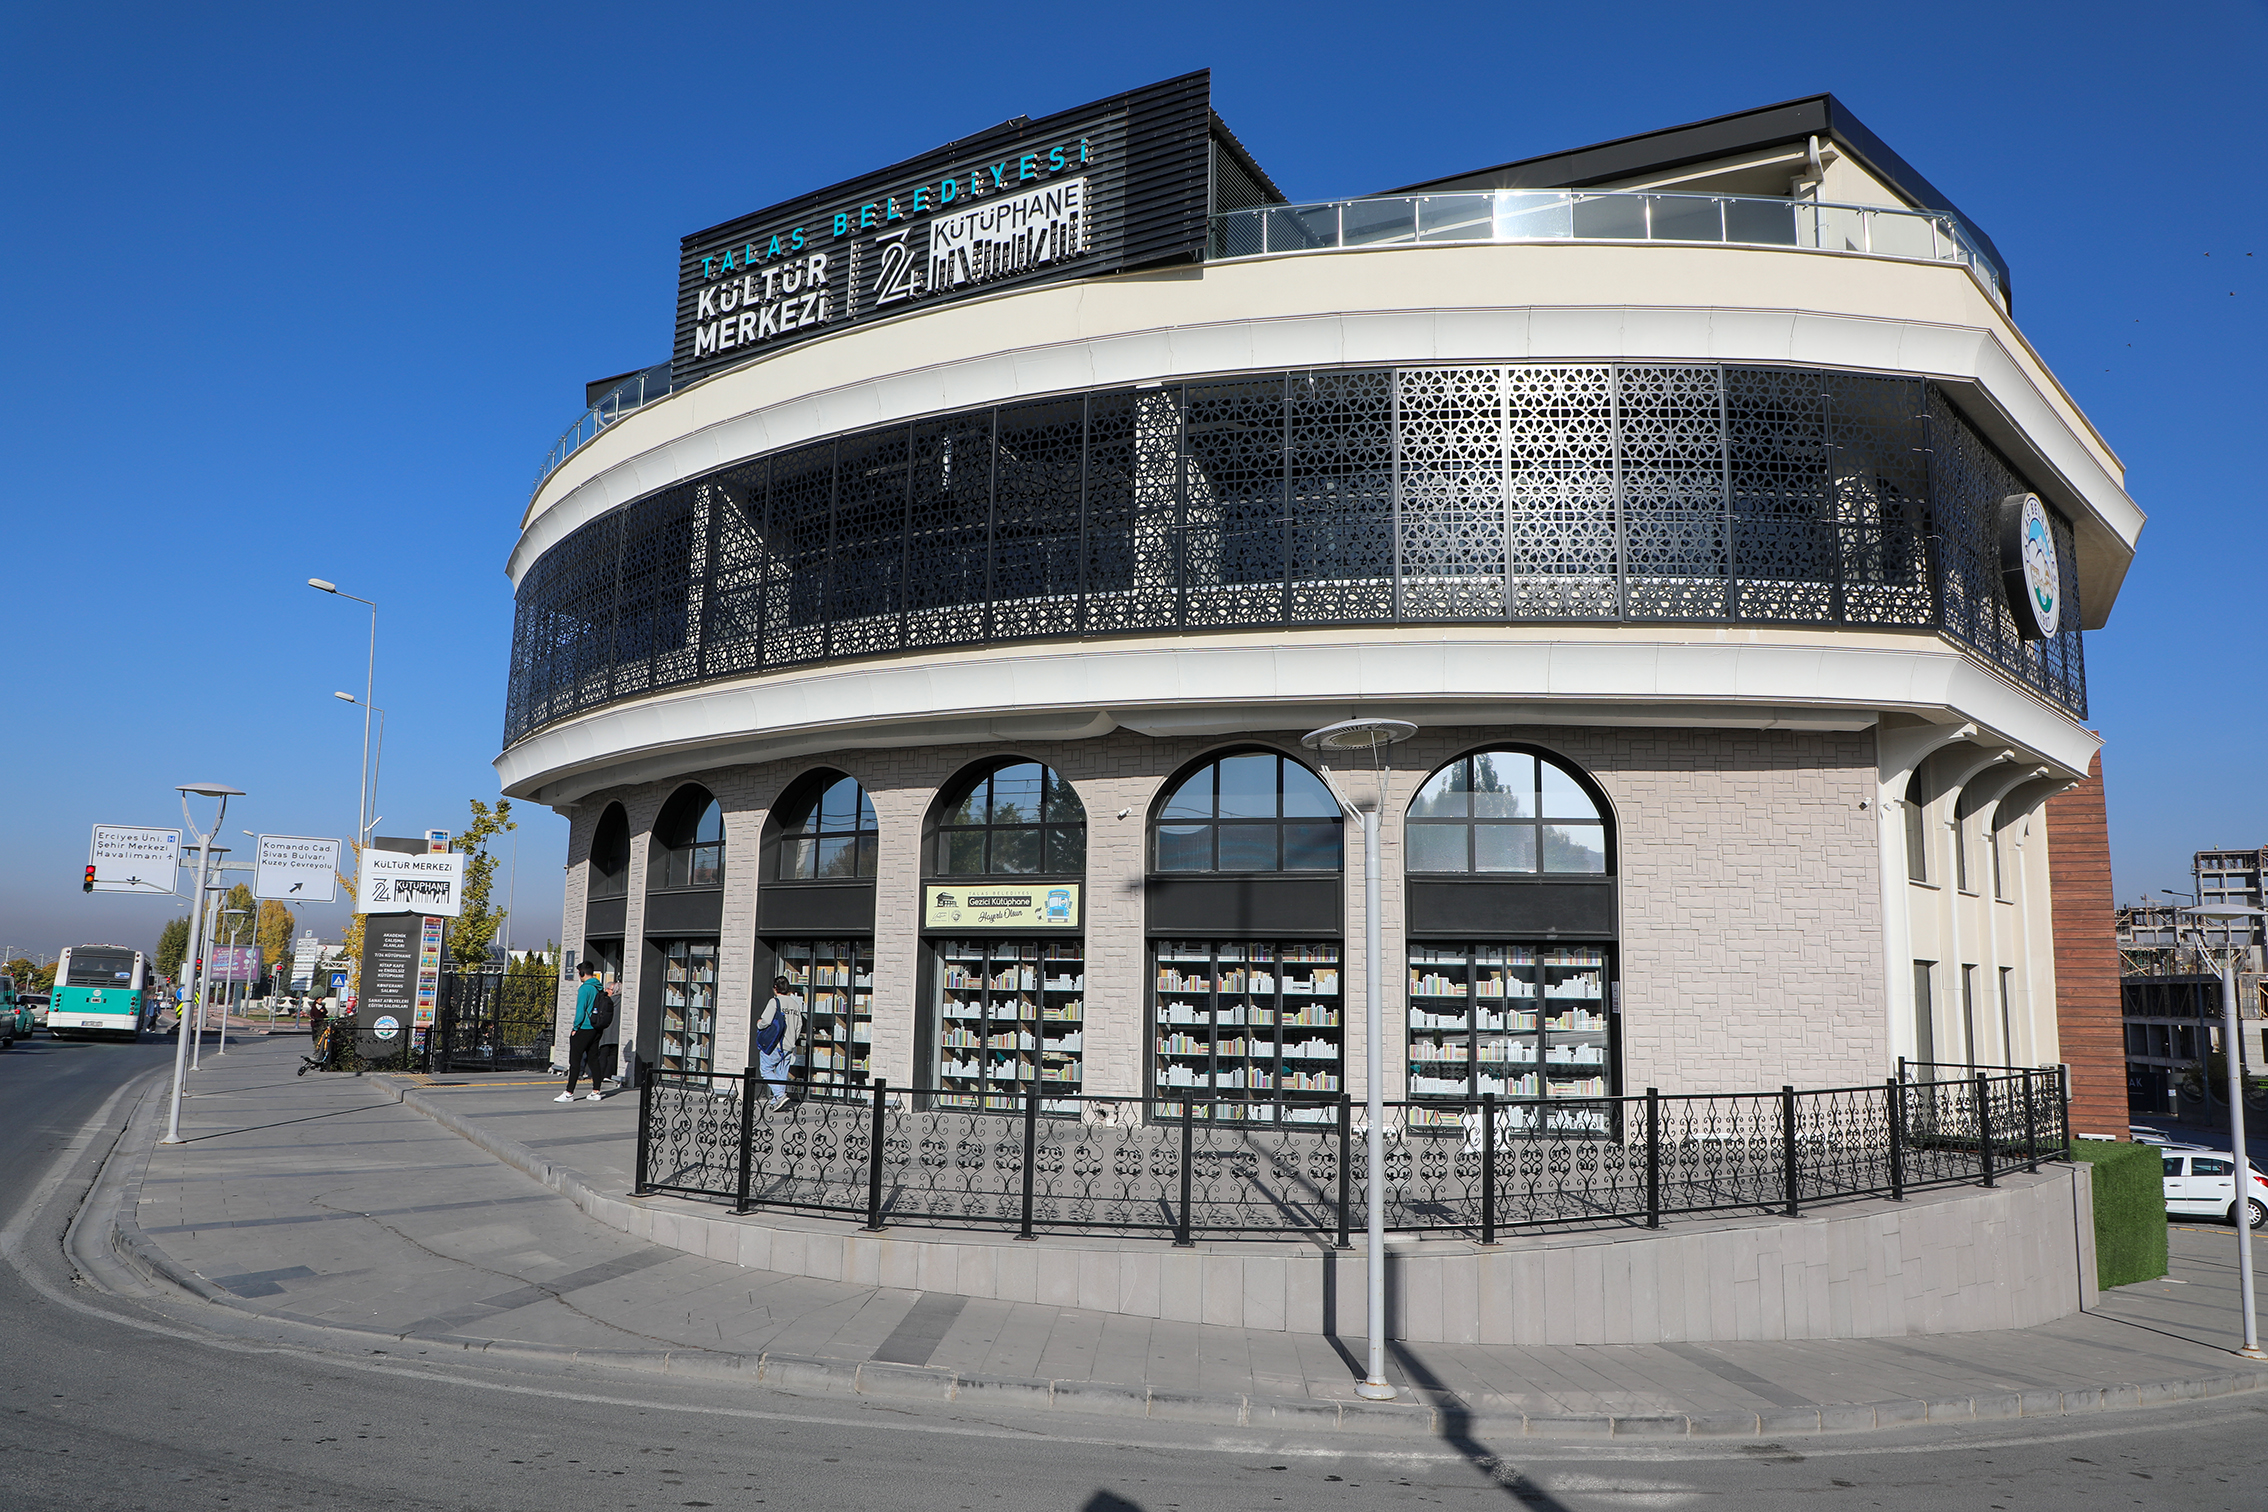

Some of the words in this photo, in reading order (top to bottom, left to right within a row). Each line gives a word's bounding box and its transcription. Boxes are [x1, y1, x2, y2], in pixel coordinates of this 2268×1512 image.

[702, 227, 806, 278] TALAS
[833, 138, 1087, 237] BELEDİYESİ
[934, 183, 1080, 250] KÜTÜPHANE
[697, 253, 828, 320] KÜLTÜR
[694, 290, 826, 357] MERKEZİ
[98, 831, 139, 842] Erciyes
[142, 833, 163, 842] Üni.
[97, 841, 125, 849] Şehir
[128, 842, 168, 851] Merkezi
[263, 841, 310, 851] Komando
[312, 844, 332, 852] Cad.
[96, 850, 162, 860] Havalimanı
[263, 850, 288, 858] Sivas
[292, 852, 325, 860] Bulvarı
[262, 859, 287, 867] Kuzey
[290, 861, 332, 869] Çevreyolu
[374, 860, 410, 869] KÜLTÜR
[413, 862, 452, 871] MERKEZİ
[396, 880, 449, 892] KÜTÜPHANE
[969, 897, 990, 906] Gezici
[991, 897, 1030, 907] Kütüphane
[1003, 907, 1023, 919] Olsun
